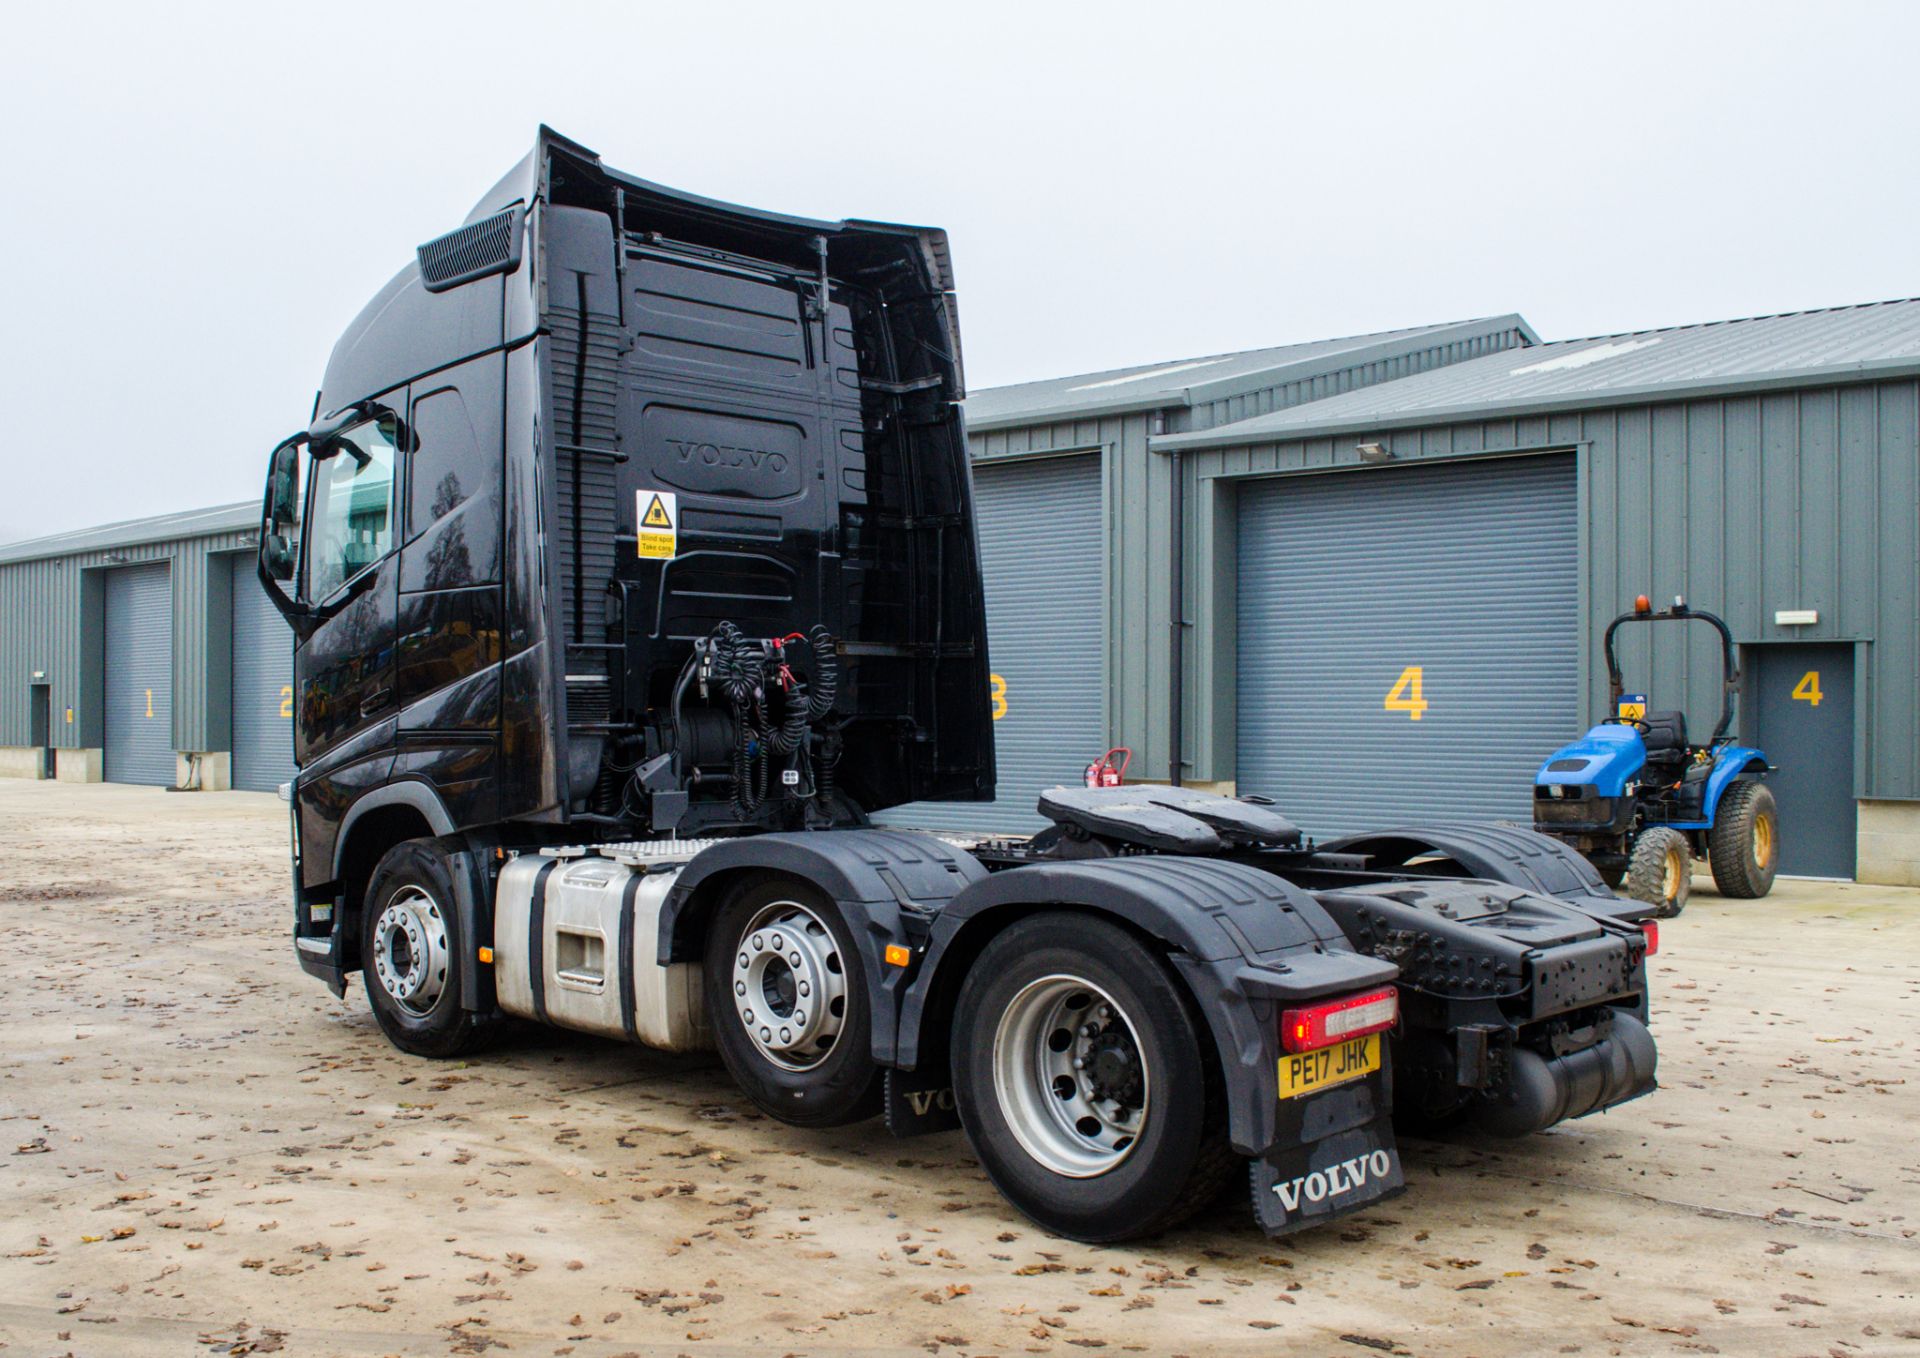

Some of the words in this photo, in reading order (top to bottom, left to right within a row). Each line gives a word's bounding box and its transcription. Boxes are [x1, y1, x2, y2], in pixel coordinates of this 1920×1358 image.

[665, 439, 788, 474] VOLVO
[145, 688, 154, 718] 1
[1384, 666, 1428, 720] 4
[1792, 671, 1824, 706] 4
[1291, 1049, 1331, 1089] PE17
[1336, 1038, 1369, 1074] JHK
[1272, 1149, 1390, 1212] VOLVO
